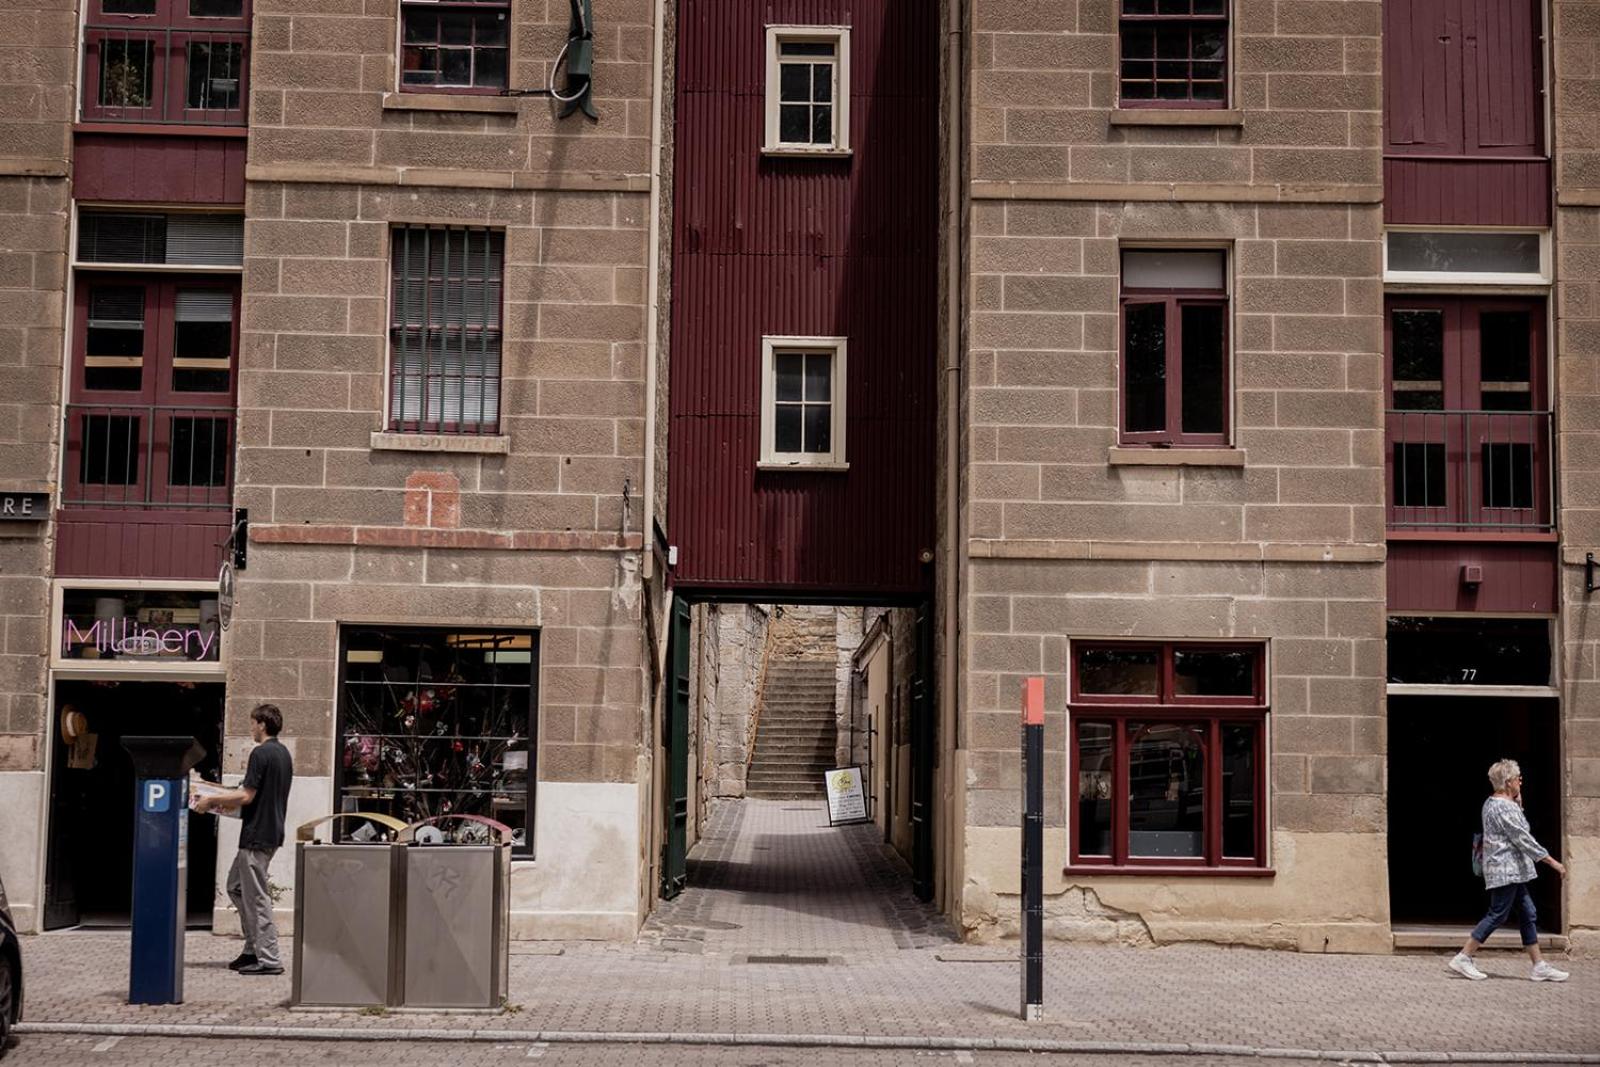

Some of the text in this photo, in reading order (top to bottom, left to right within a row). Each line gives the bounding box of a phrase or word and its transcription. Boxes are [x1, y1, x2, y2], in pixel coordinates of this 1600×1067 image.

[3, 497, 33, 514] RE
[67, 616, 215, 661] Millinery
[1461, 668, 1477, 681] 77
[148, 783, 166, 808] P
